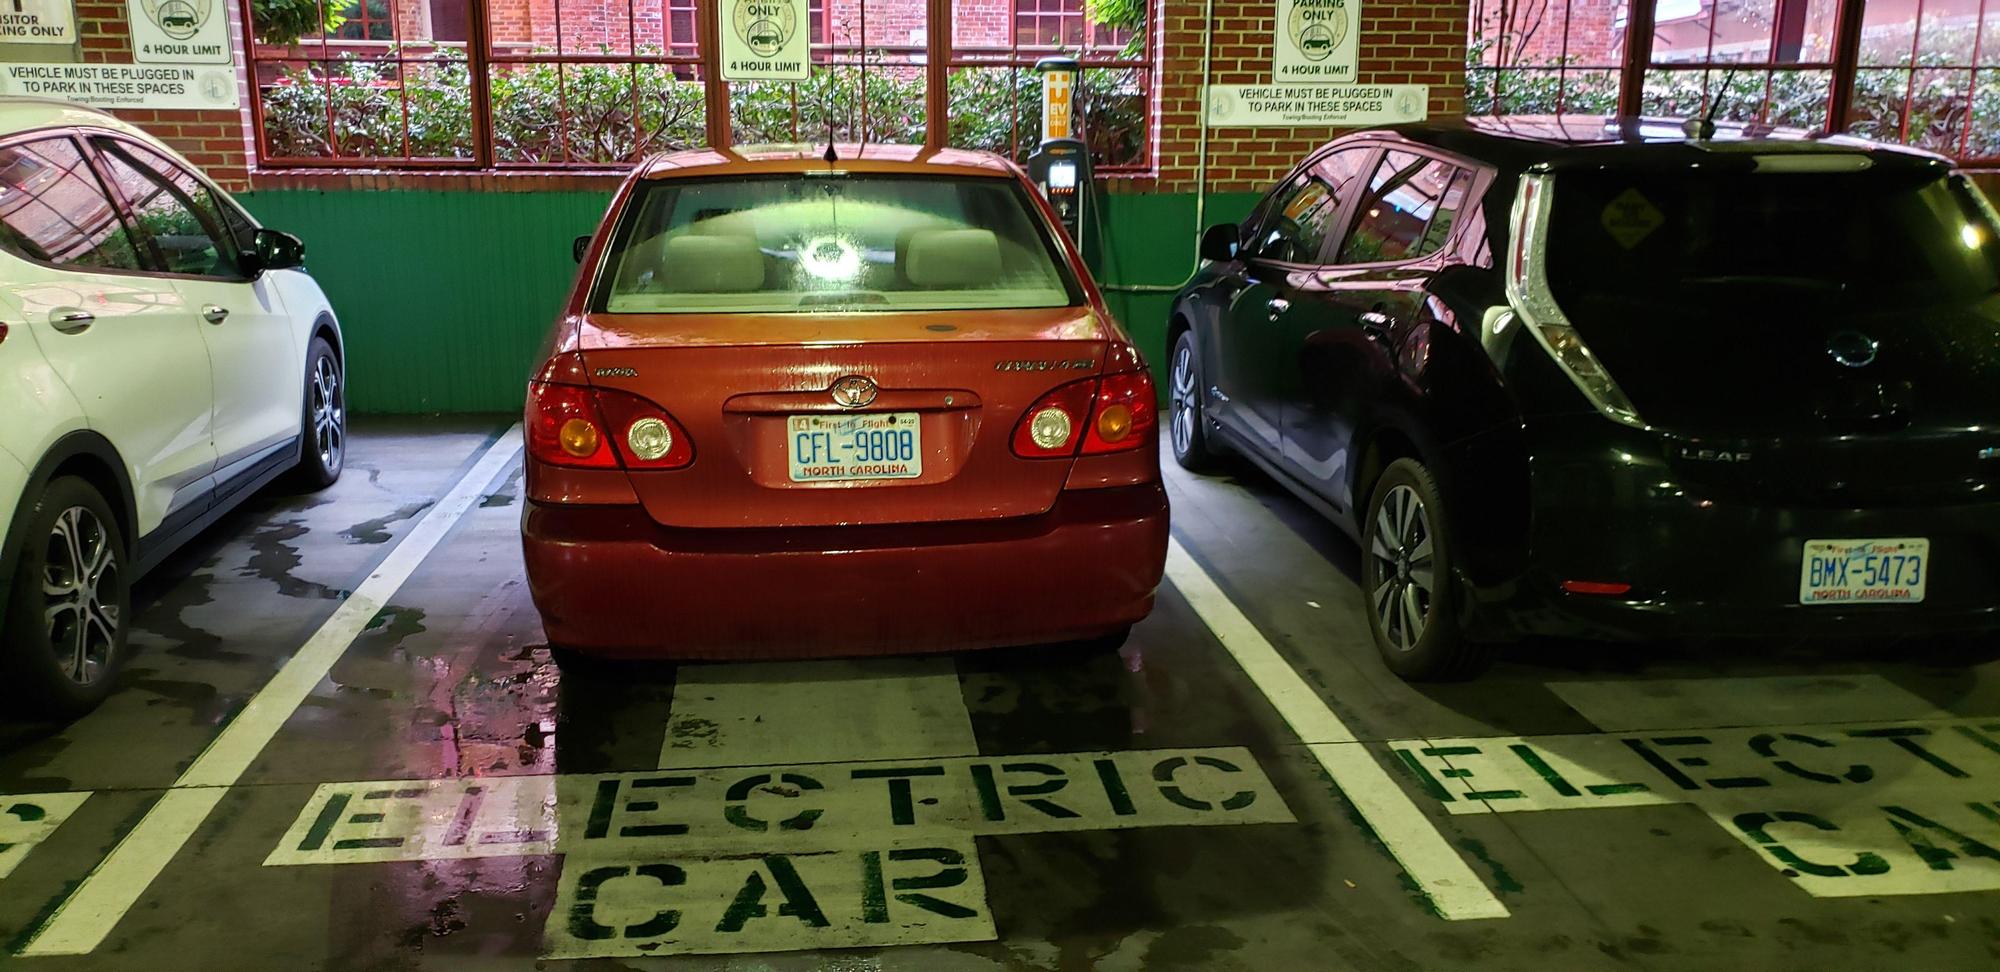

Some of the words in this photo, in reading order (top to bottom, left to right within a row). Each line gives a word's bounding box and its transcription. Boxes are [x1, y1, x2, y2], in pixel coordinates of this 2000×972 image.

[748, 5, 780, 16] ONLY
[1302, 10, 1334, 20] ONLY
[0, 15, 39, 25] ISITOR
[31, 26, 64, 36] ONLY
[143, 44, 150, 53] 4
[154, 45, 189, 55] HOUR
[192, 45, 221, 55] LIMIT
[730, 61, 737, 70] 4
[741, 61, 771, 71] HOUR
[775, 62, 801, 72] LIMIT
[1281, 65, 1288, 74] 4
[1291, 65, 1320, 74] HOUR
[1324, 65, 1349, 74] LIMIT
[9, 67, 61, 79] VEHICLE
[64, 67, 98, 79] MUST
[101, 68, 118, 79] BE
[121, 69, 179, 80] PLUGGED
[182, 69, 195, 80] IN
[23, 81, 40, 93] TO
[43, 81, 77, 93] PARK
[79, 82, 91, 93] IN
[94, 82, 134, 94] THESE
[136, 83, 185, 94] SPACES
[1239, 88, 1282, 99] VEHICLE
[1284, 88, 1313, 98] MUST
[1315, 88, 1330, 98] BE
[1332, 88, 1381, 98] PLUGGED
[1383, 88, 1393, 98] IN
[1248, 101, 1262, 112] TO
[1264, 101, 1293, 112] PARK
[1294, 102, 1305, 112] IN
[1307, 101, 1340, 112] THESE
[1342, 101, 1383, 111] SPACES
[819, 420, 842, 430] First
[862, 418, 889, 429] Flight
[796, 430, 914, 465] CFL-9808
[1681, 448, 1752, 462] LEAF
[803, 466, 845, 477] NORTH
[849, 464, 908, 476] CAROLINA
[1809, 555, 1921, 588] BMX-5473
[1812, 589, 1851, 600] NORTH
[1855, 588, 1911, 599] CAROLINA
[296, 755, 1257, 850] ELECTRIC
[1732, 802, 2000, 877] CA
[568, 847, 978, 940] CAR
